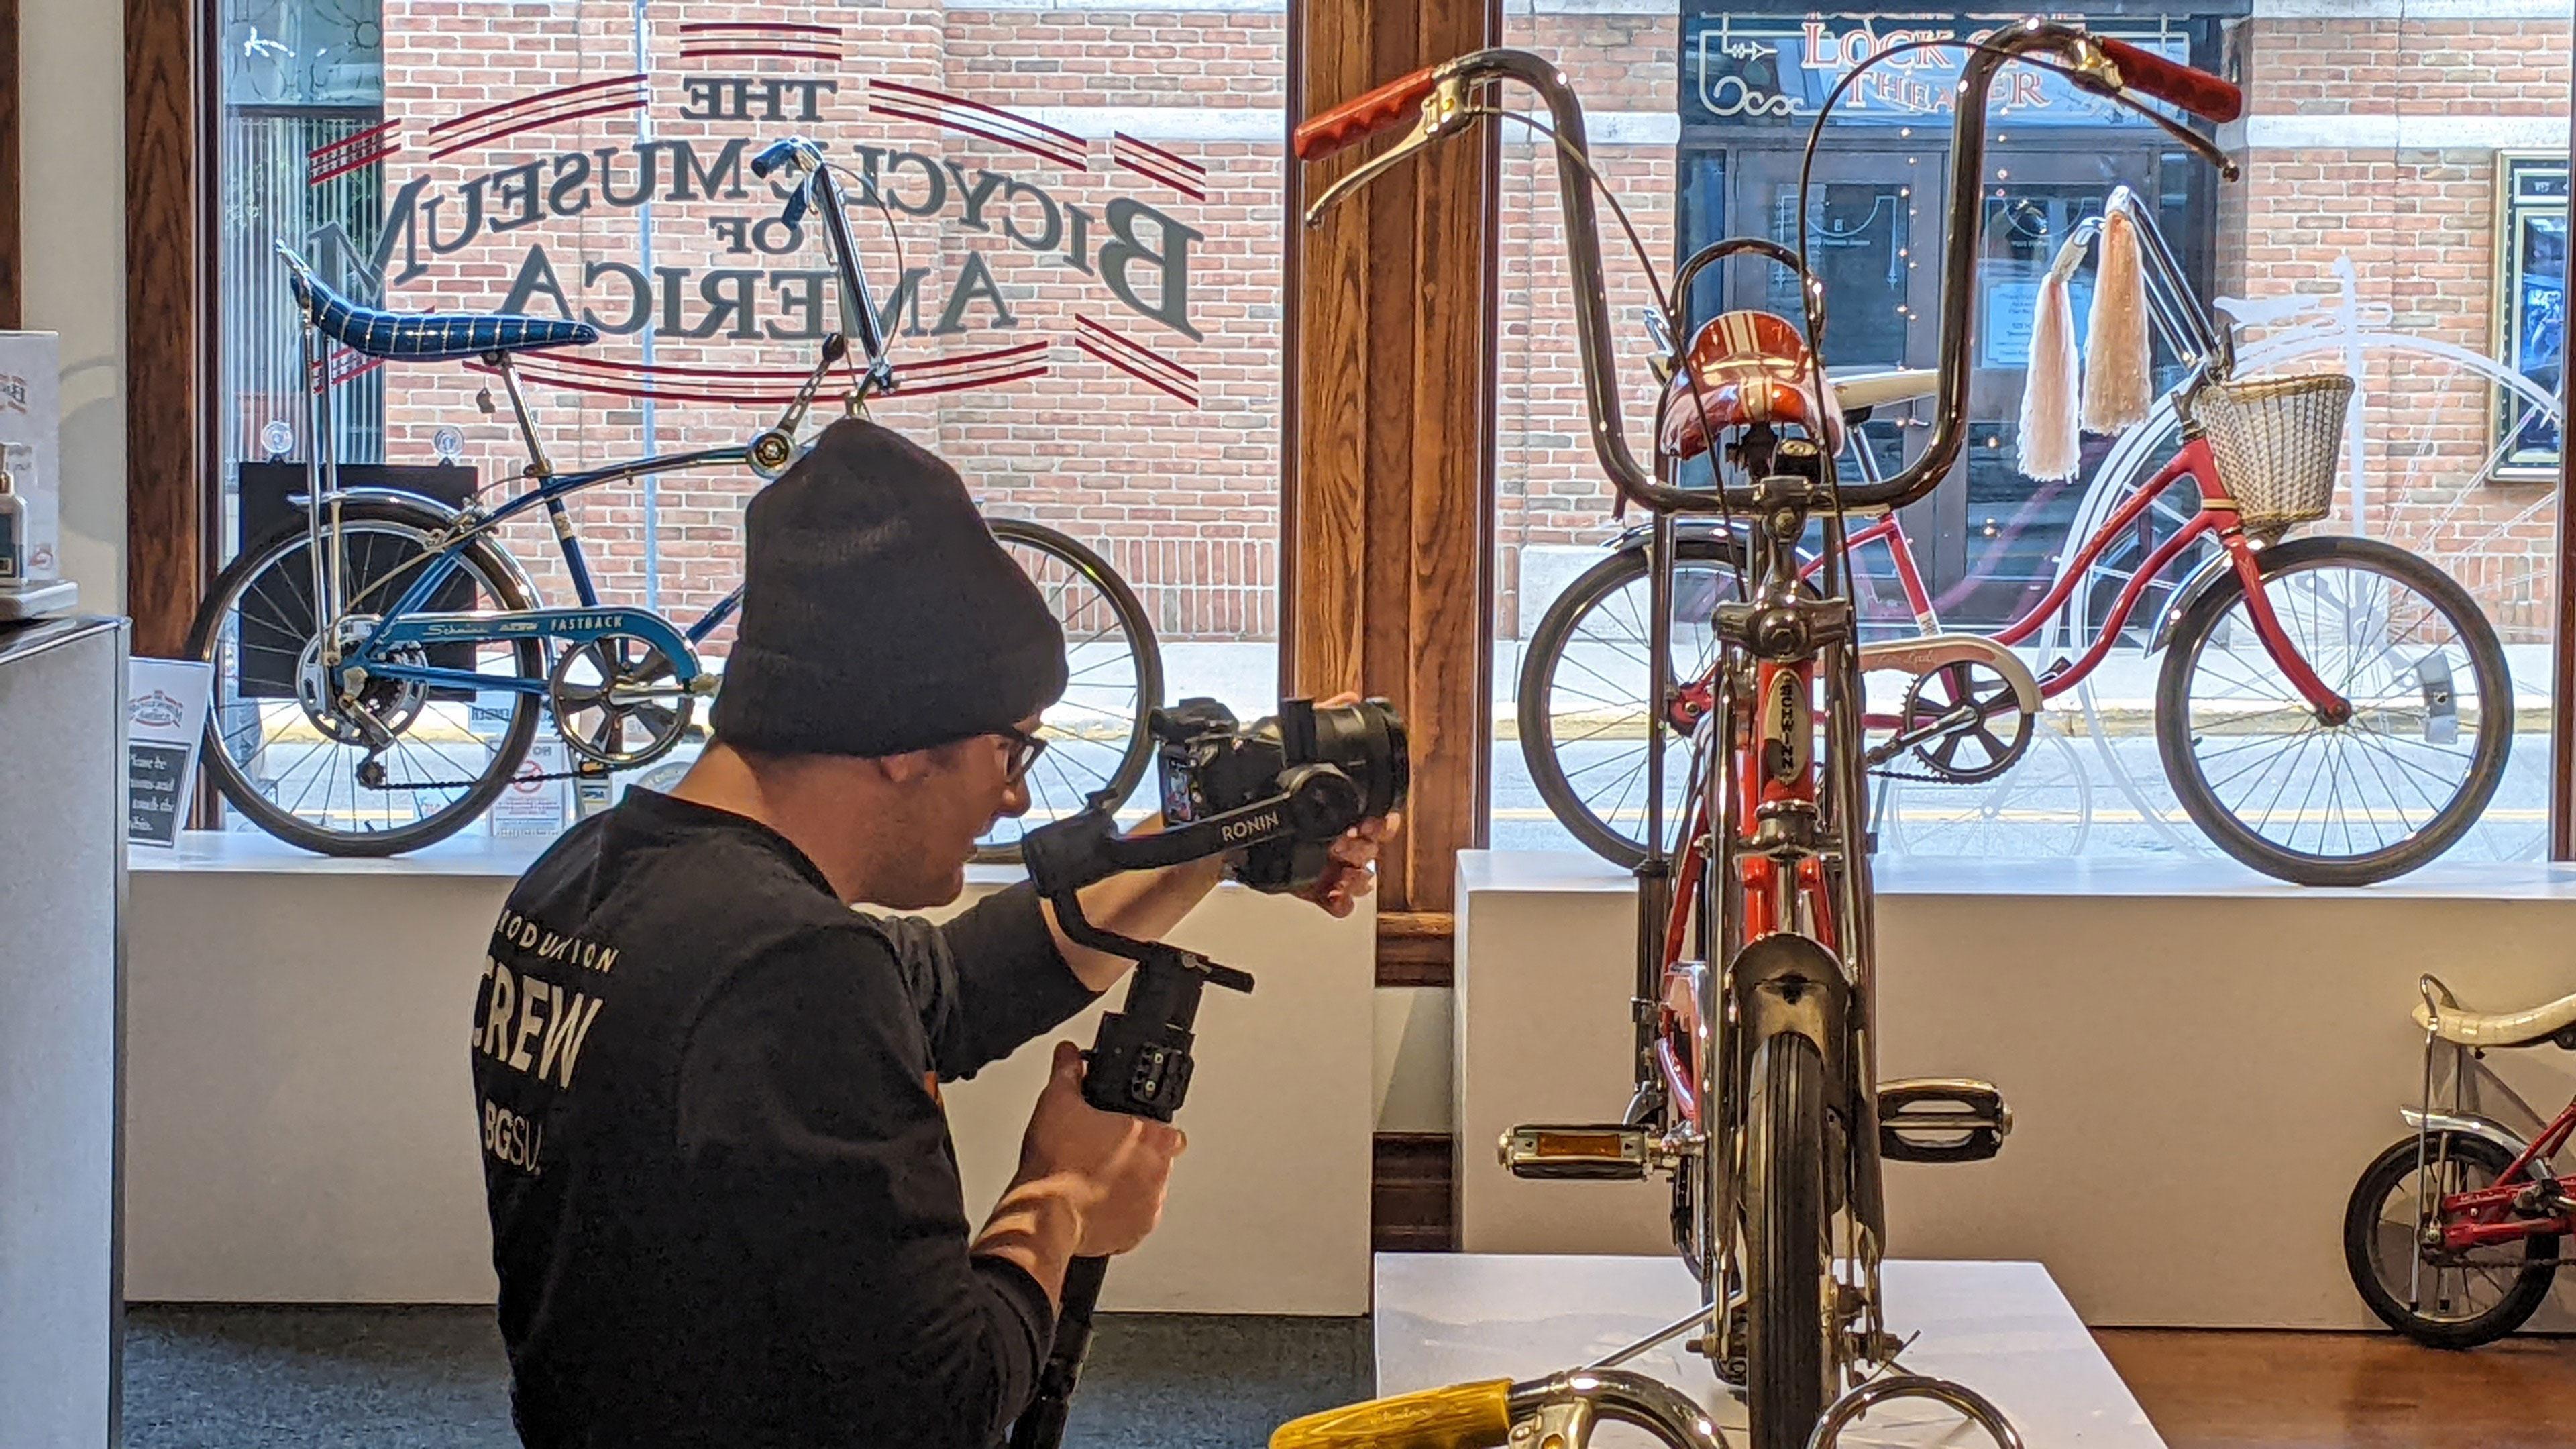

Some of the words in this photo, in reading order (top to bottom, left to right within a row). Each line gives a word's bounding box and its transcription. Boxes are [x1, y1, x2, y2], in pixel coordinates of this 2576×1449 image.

[1801, 21, 1956, 69] LOCK
[1837, 70, 2053, 113] THEAER
[550, 615, 623, 631] FASTBACK
[1779, 684, 1794, 770] SCHWINN
[1222, 810, 1279, 841] RONIN
